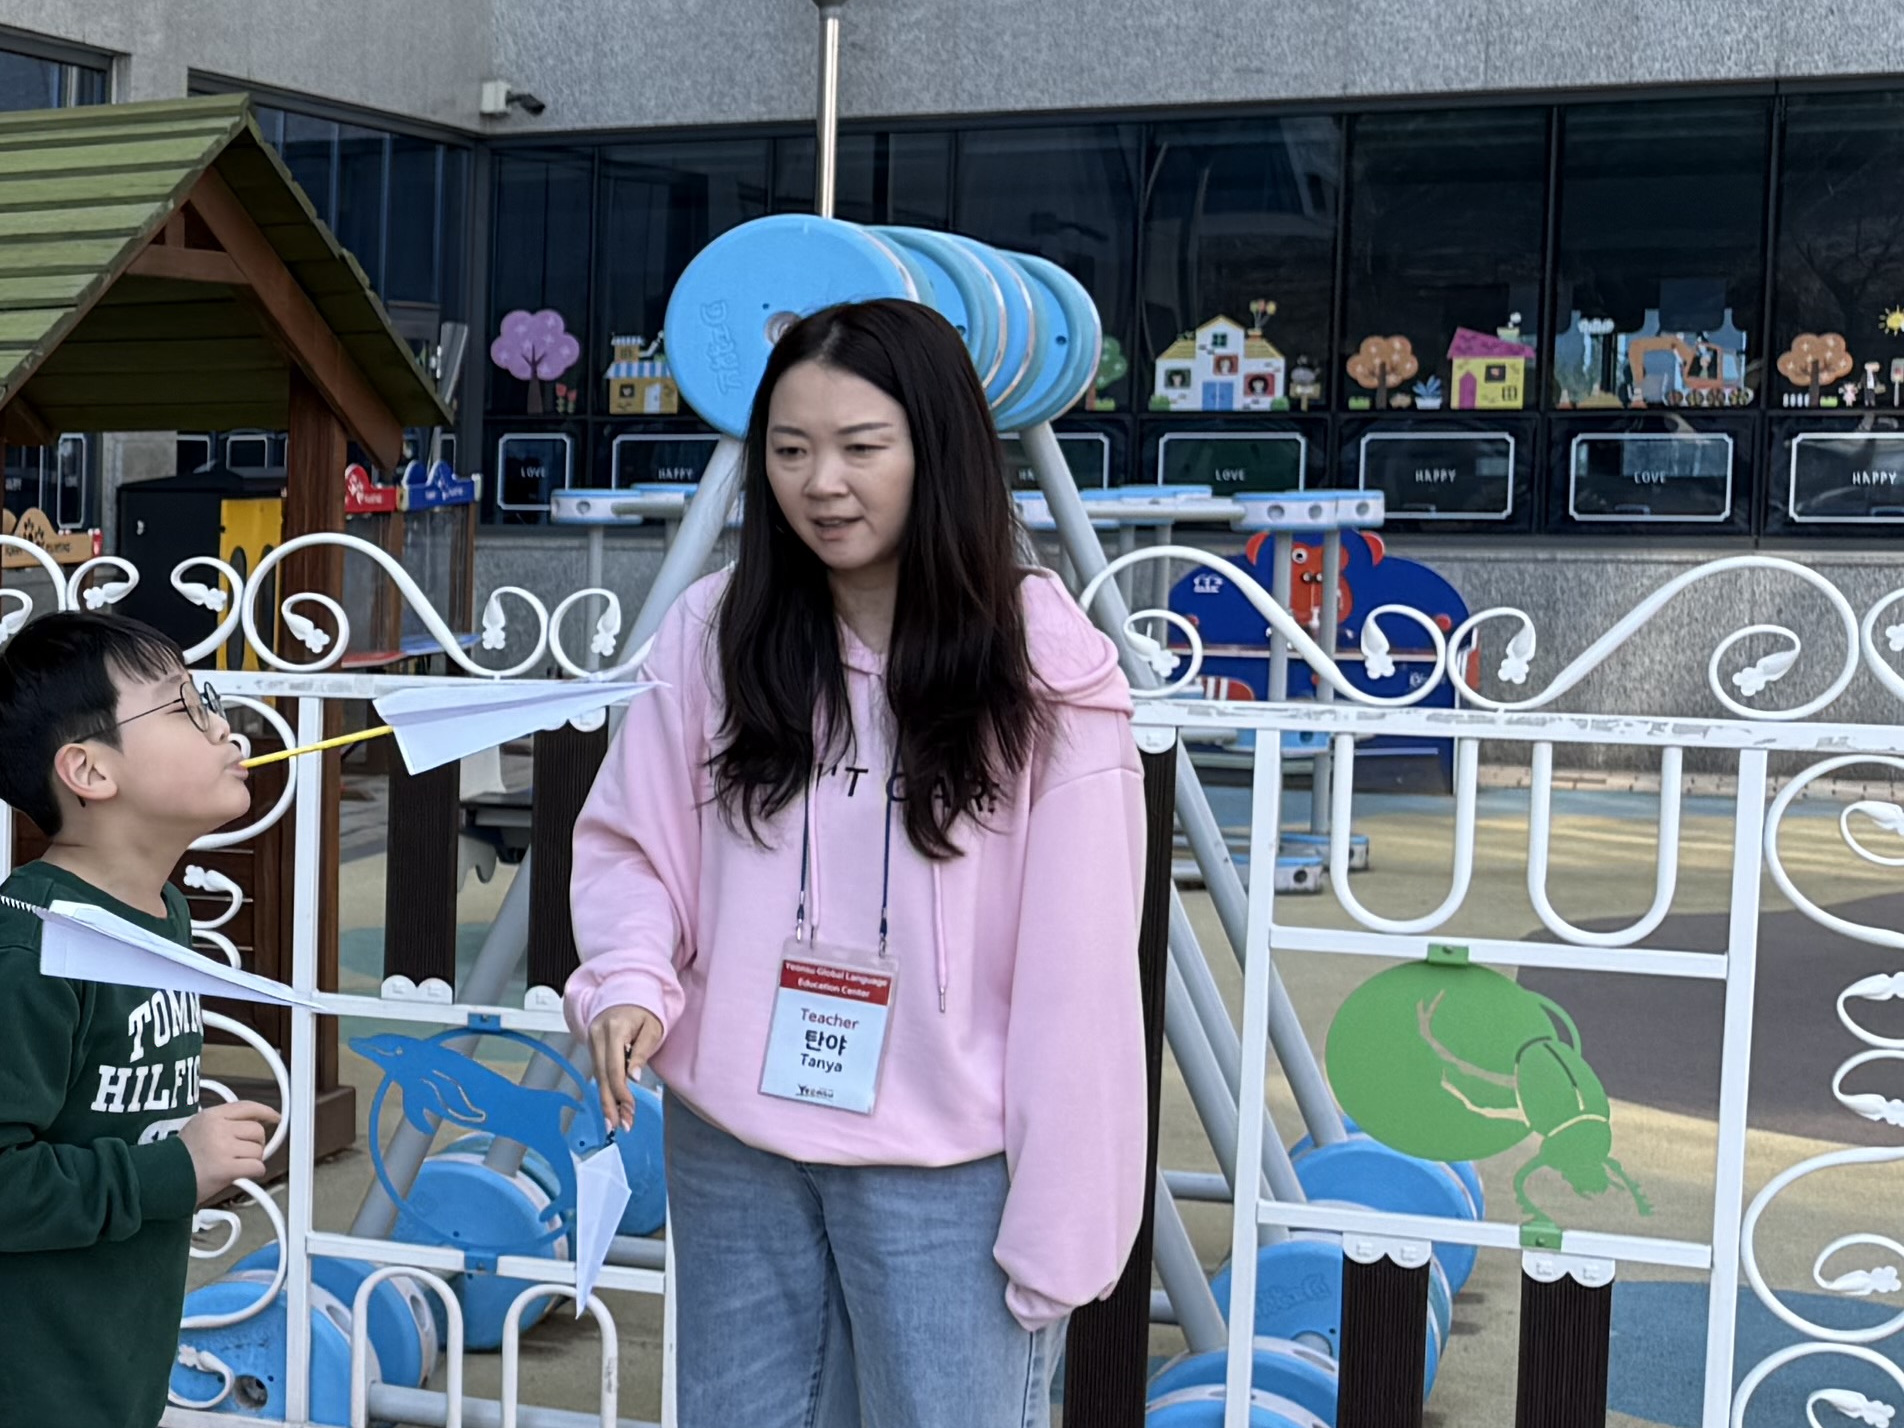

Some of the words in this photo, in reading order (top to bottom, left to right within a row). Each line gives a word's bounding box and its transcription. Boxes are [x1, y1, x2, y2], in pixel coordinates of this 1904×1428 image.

[658, 467, 693, 480] HAPPY
[1215, 468, 1246, 482] LOVE
[1415, 468, 1457, 484] HAPPY
[1852, 470, 1897, 486] HAPPY
[797, 977, 841, 993] Education
[841, 985, 871, 998] Center
[816, 966, 845, 980] Global
[845, 971, 888, 988] Language
[800, 1007, 860, 1030] Teacher
[804, 1029, 848, 1057] 탄야
[800, 1052, 843, 1074] Tanya
